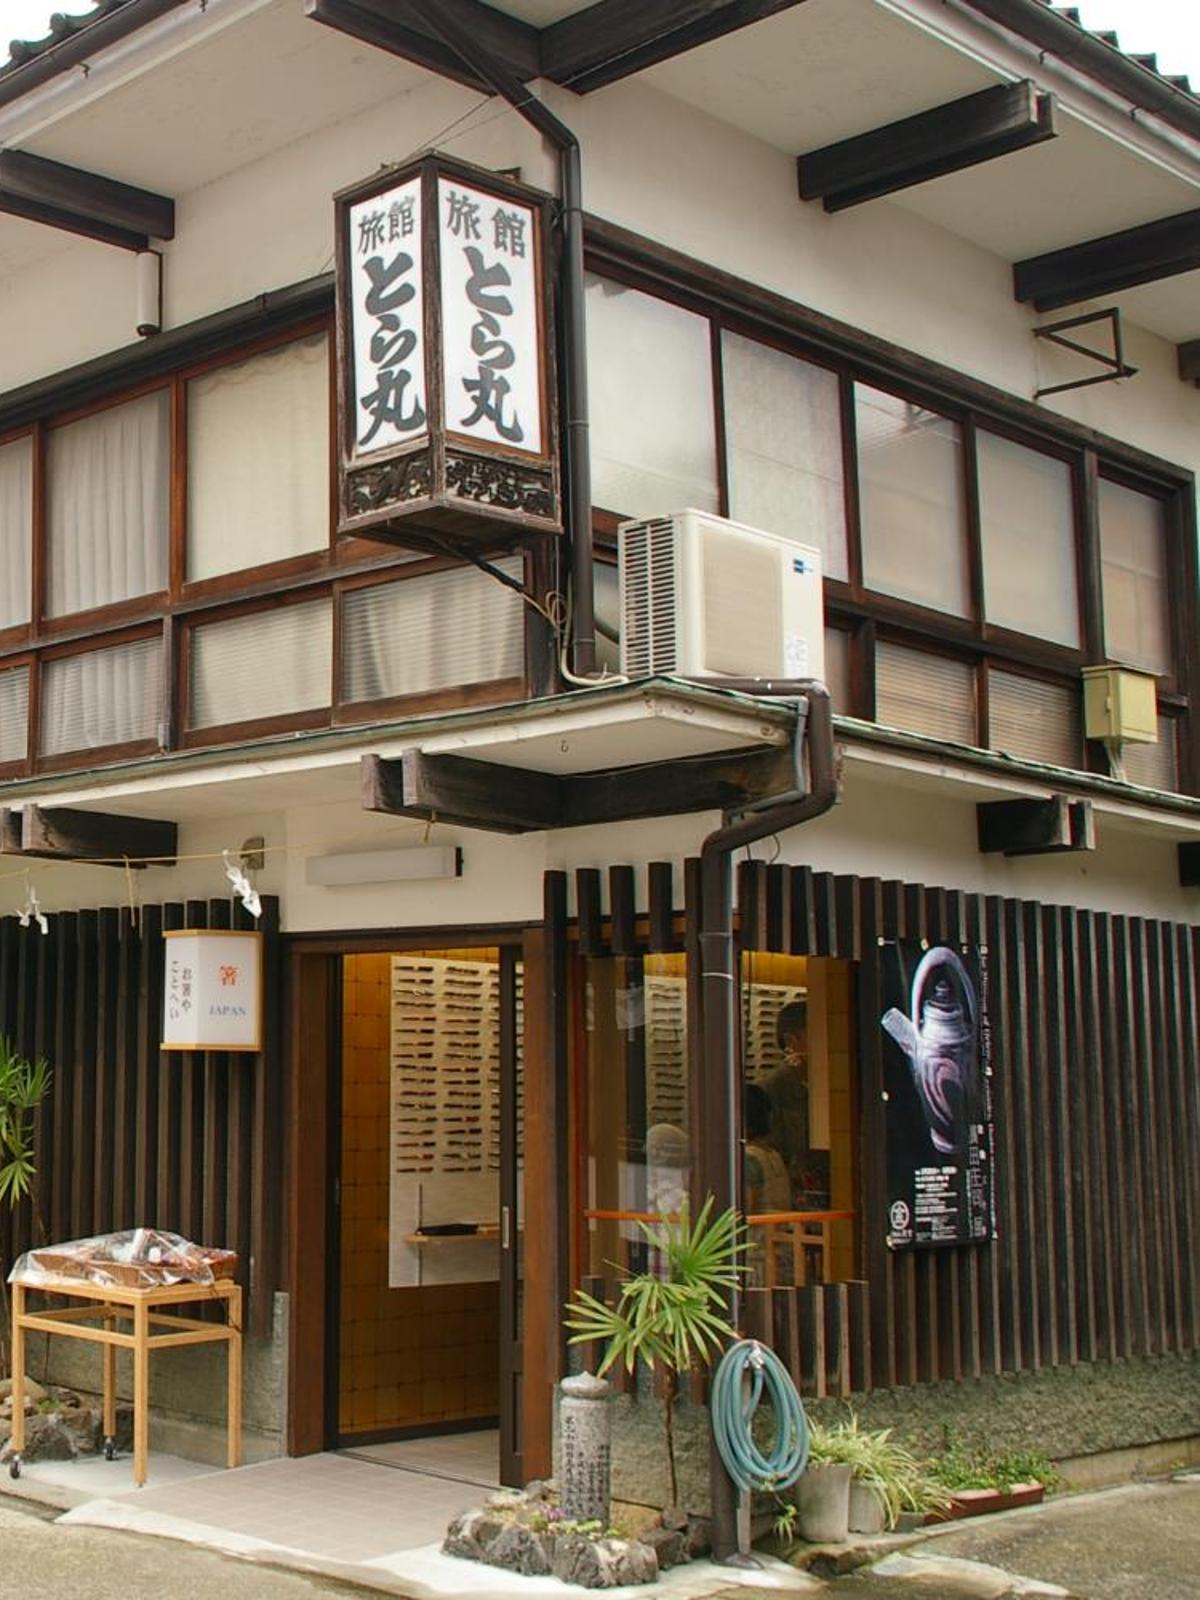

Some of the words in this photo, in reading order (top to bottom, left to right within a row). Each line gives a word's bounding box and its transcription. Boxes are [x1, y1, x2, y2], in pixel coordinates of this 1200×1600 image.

[357, 195, 415, 254] 旅館
[445, 190, 527, 259] 旅館
[358, 251, 426, 447] とら丸
[461, 246, 524, 444] とら丸
[209, 1005, 247, 1018] JAPAN
